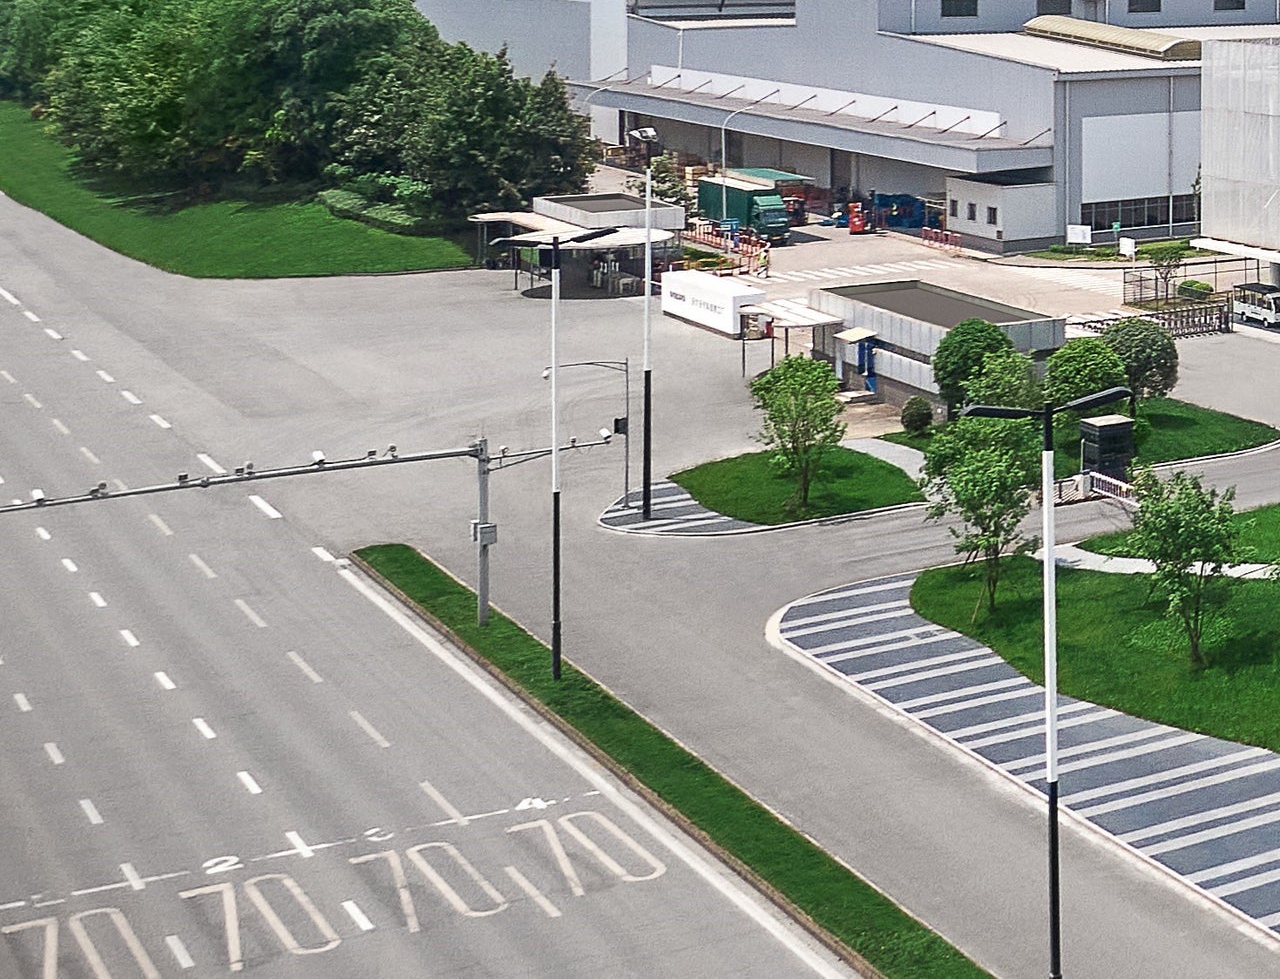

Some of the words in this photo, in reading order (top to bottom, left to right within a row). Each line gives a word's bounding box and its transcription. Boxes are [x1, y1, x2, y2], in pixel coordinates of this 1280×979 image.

[202, 856, 244, 874] 2
[349, 842, 509, 933] 70
[505, 812, 667, 897] 70
[1, 908, 162, 979] 70
[178, 874, 341, 971] 70
